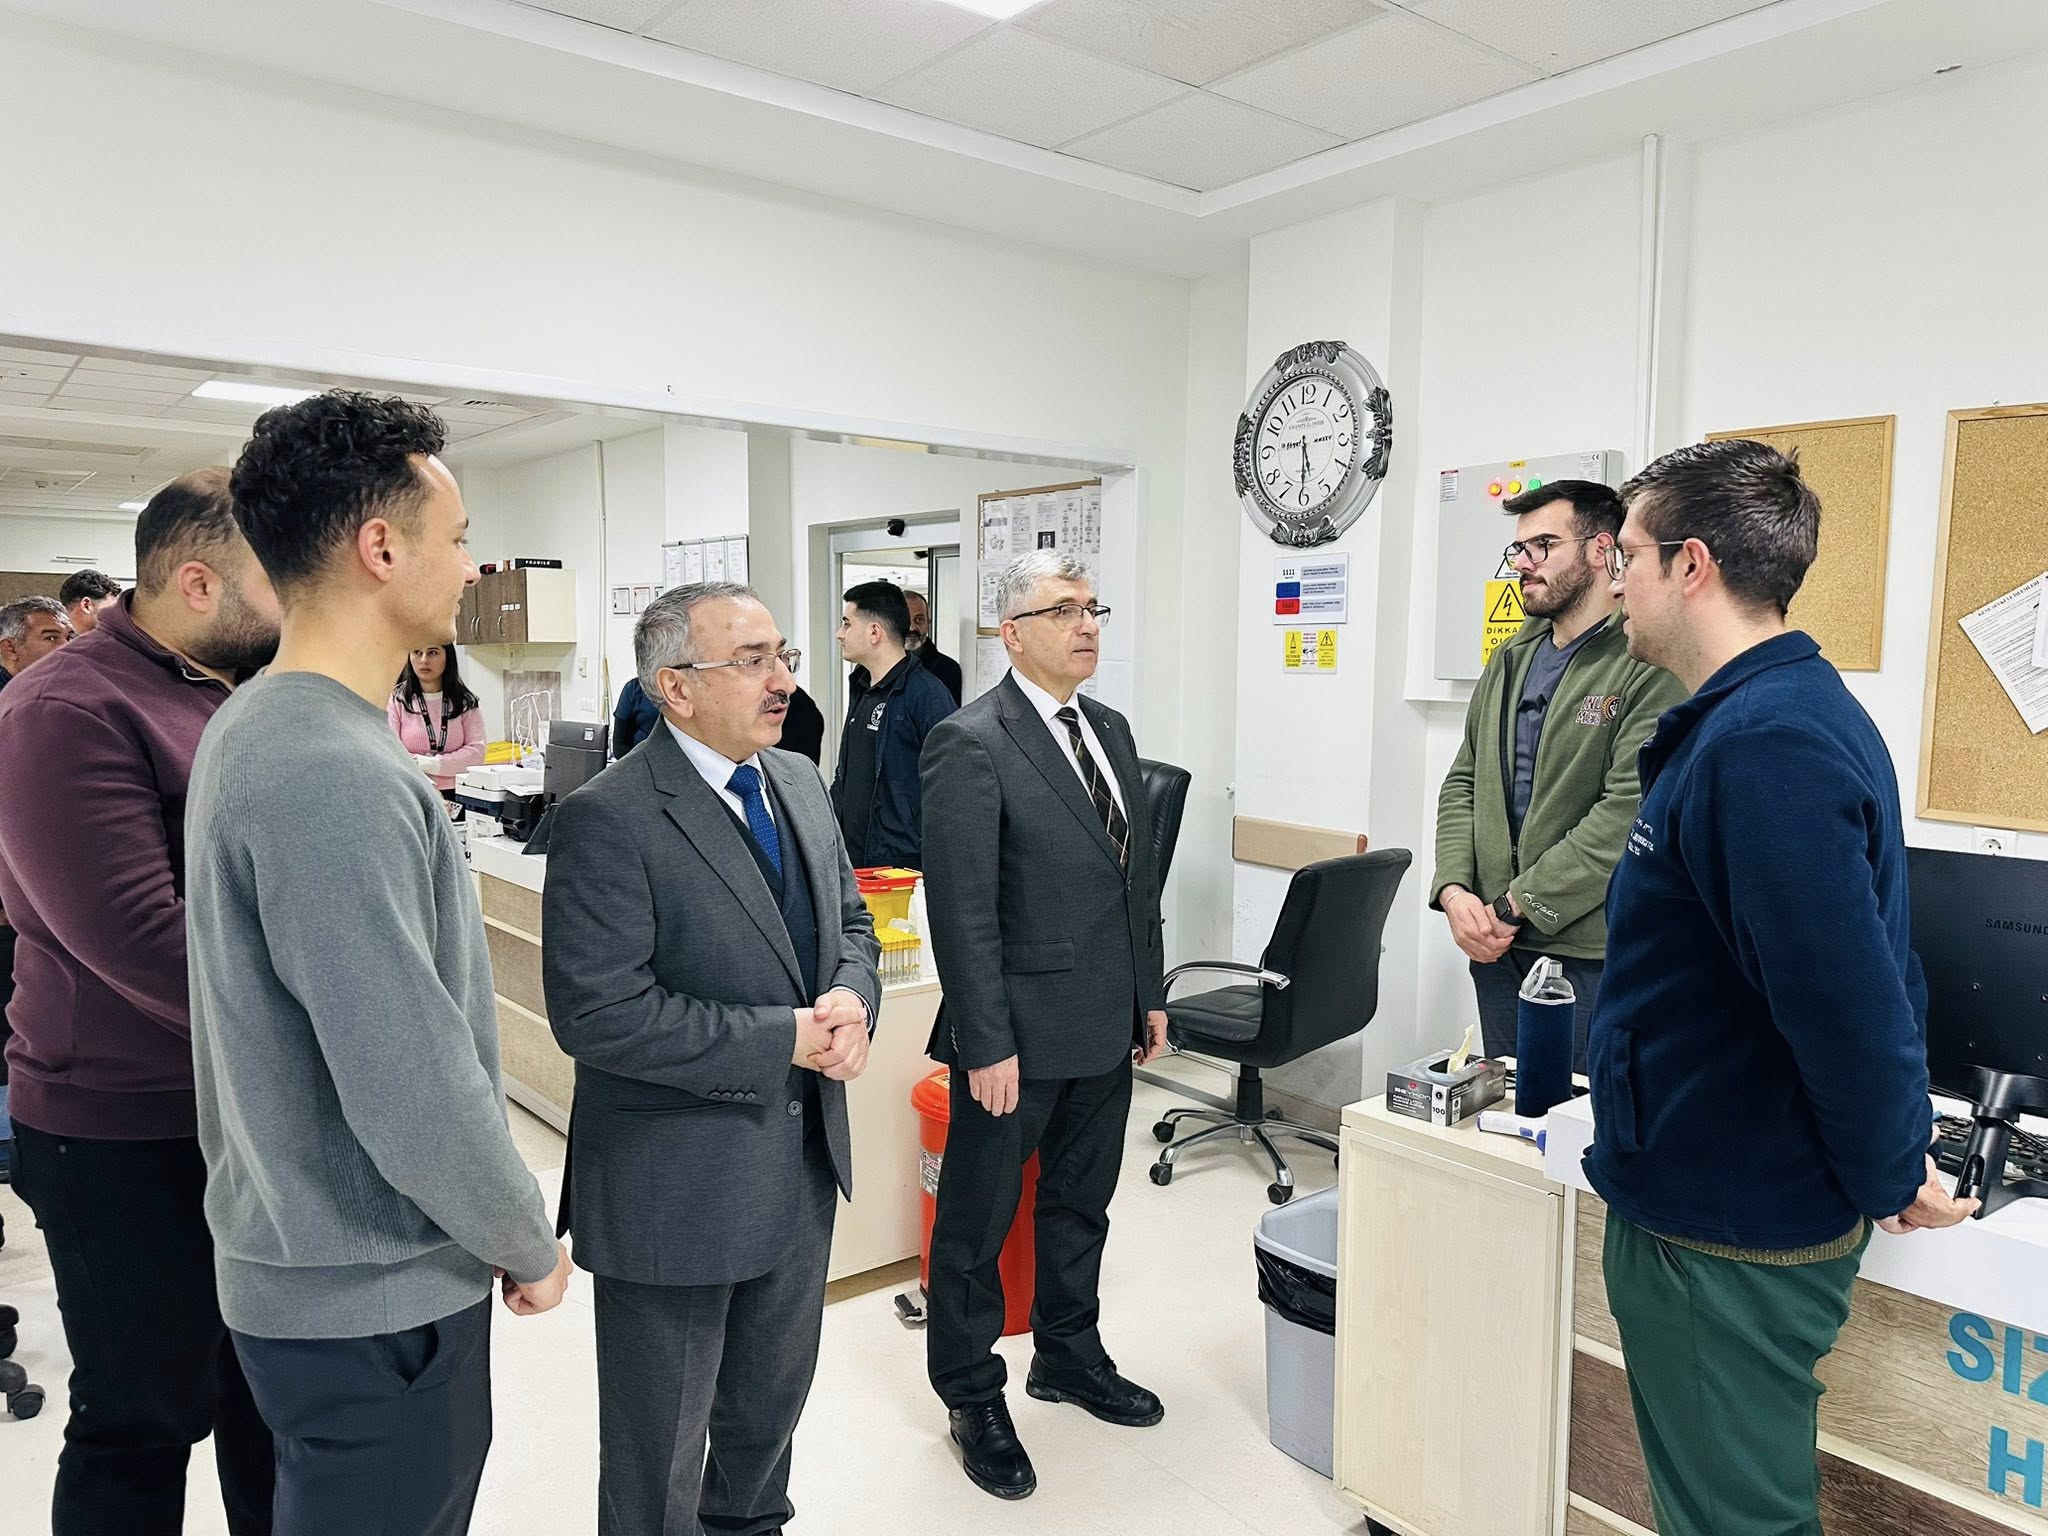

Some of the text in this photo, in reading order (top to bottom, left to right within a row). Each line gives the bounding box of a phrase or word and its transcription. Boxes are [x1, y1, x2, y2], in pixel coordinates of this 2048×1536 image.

[1301, 383, 1317, 405] 12
[1322, 388, 1332, 408] 1
[1281, 394, 1297, 417] 11
[1332, 403, 1350, 423] 2
[1266, 416, 1284, 437] 10
[1337, 432, 1351, 448] 3
[1261, 445, 1276, 461] 9
[1334, 457, 1348, 475] 4
[1265, 468, 1281, 486] 8
[1278, 480, 1293, 500] 7
[1298, 486, 1310, 507] 6
[1317, 478, 1332, 498] 5
[1486, 626, 1521, 635] DIKKA
[1432, 1106, 1446, 1115] 100
[1987, 1425, 2045, 1509] H
